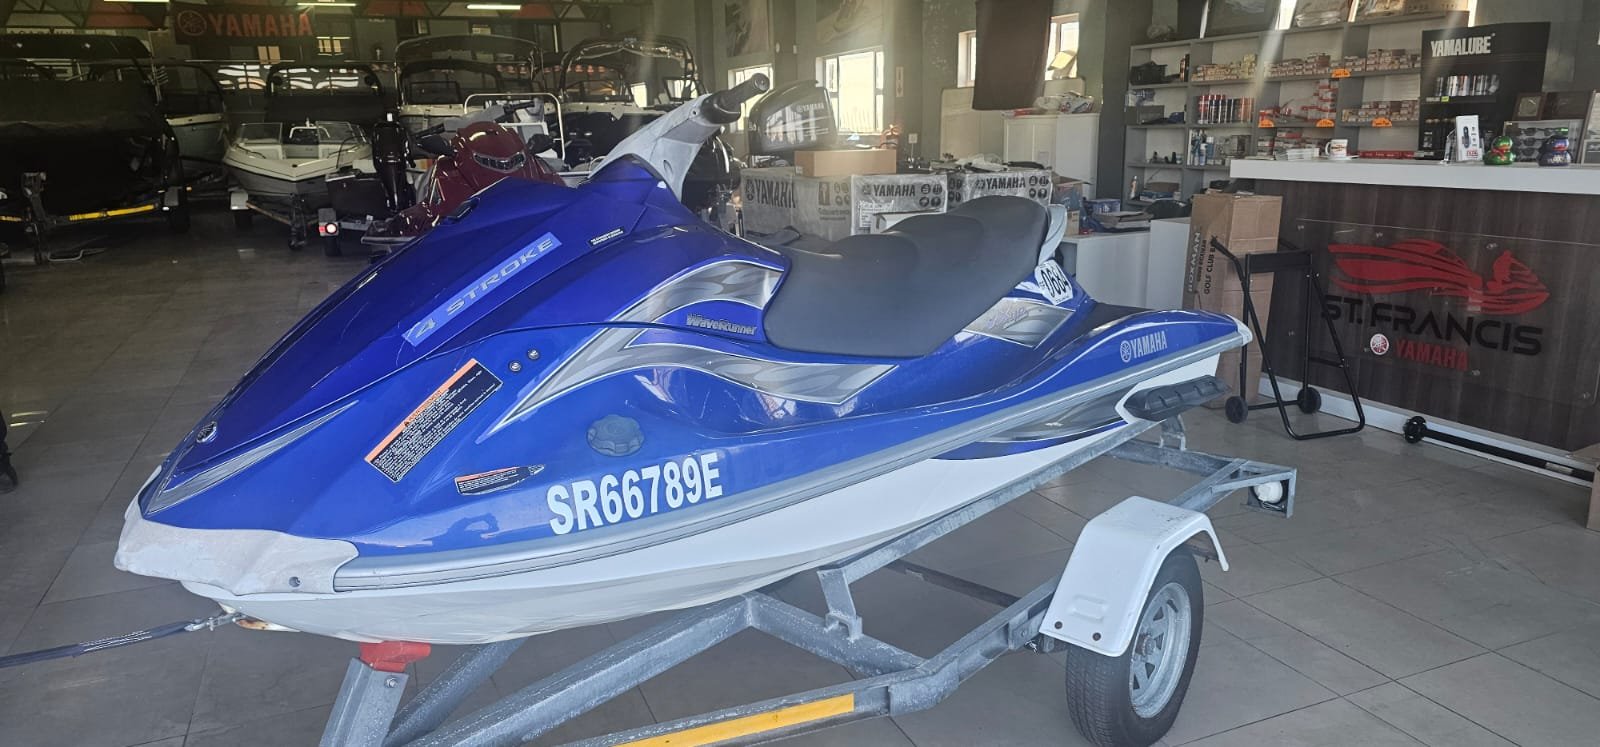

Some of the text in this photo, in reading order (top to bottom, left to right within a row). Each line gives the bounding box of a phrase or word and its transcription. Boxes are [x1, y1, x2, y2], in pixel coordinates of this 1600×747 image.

[208, 14, 313, 37] YAMAHA
[1430, 36, 1492, 57] YAMALUBE
[873, 184, 916, 198] YAMAHA
[985, 176, 1026, 190] YAMAHA
[1206, 253, 1216, 273] CLUB
[414, 238, 554, 341] 4 STROKE
[1203, 273, 1213, 295] GOLF
[686, 313, 757, 336] WaveRunner
[1370, 302, 1543, 356] FRANCIS
[1130, 330, 1168, 359] YAMAHA
[1394, 338, 1470, 372] YAMAHA
[546, 452, 723, 535] SR66789E
